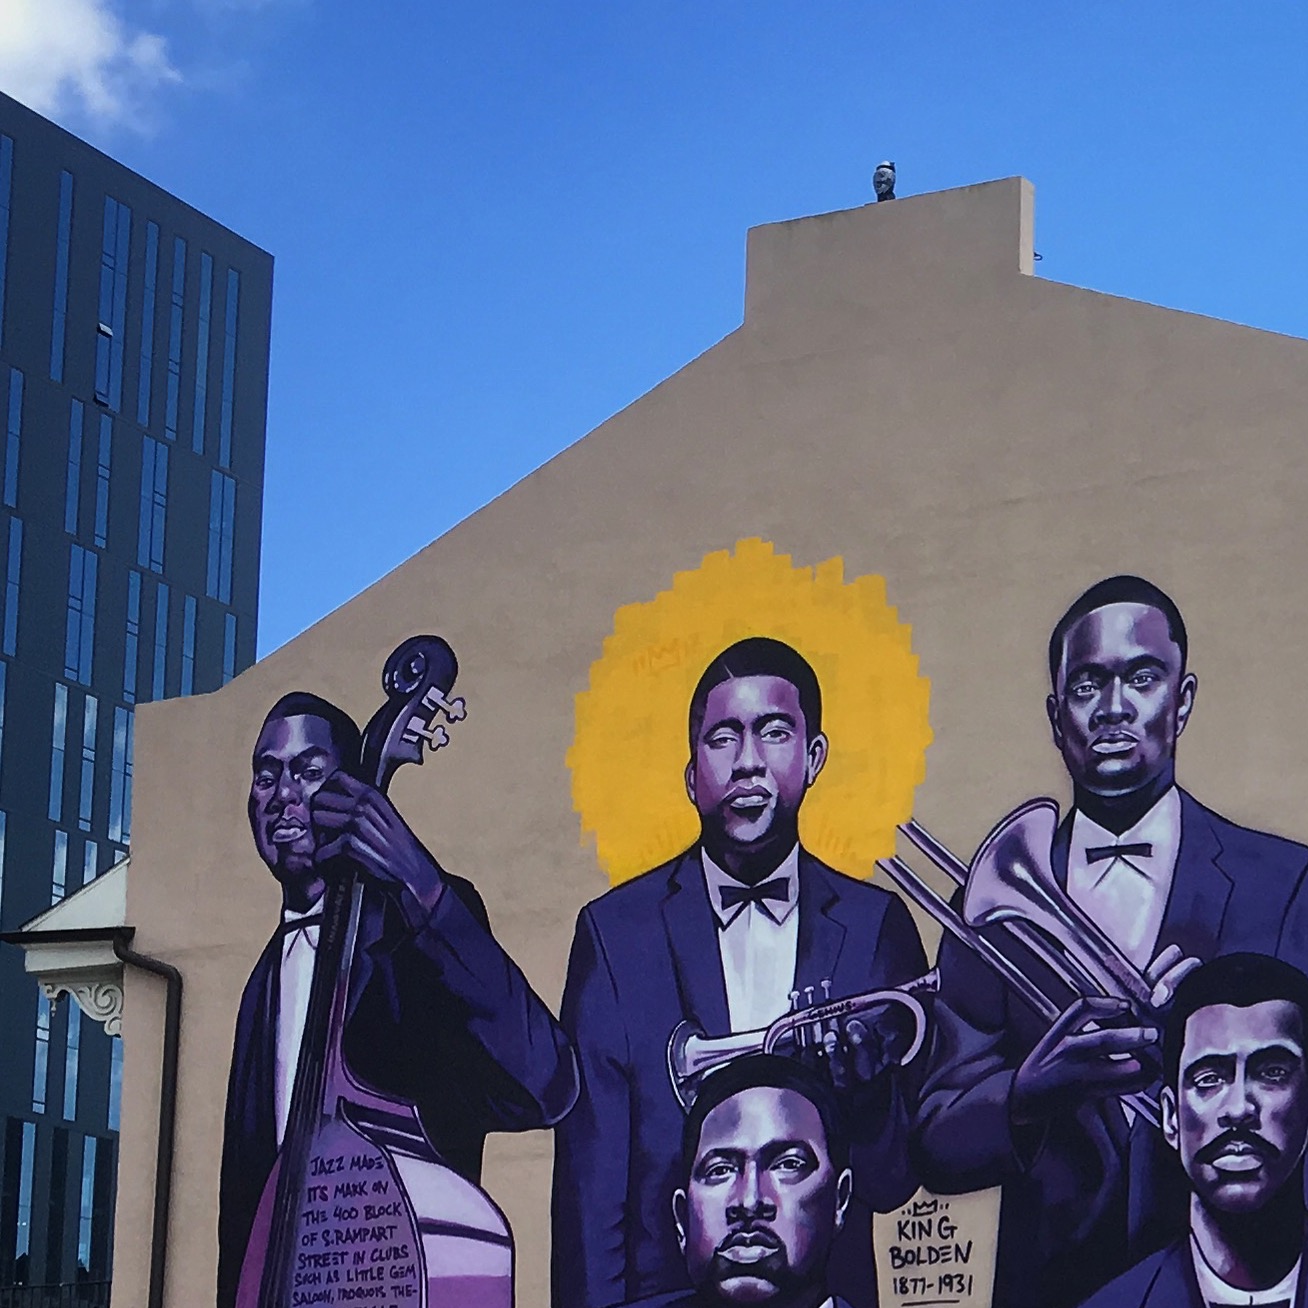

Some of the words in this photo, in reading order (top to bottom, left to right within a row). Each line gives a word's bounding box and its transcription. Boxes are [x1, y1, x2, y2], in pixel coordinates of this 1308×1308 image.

[310, 1156, 345, 1176] JAZZ
[350, 1155, 385, 1170] MADE
[307, 1184, 328, 1205] ITS
[333, 1182, 368, 1200] MARK
[372, 1180, 388, 1195] ON
[302, 1210, 328, 1226] THE
[333, 1206, 359, 1222] 400
[364, 1202, 402, 1218] BLOCK
[301, 1231, 318, 1247] OF
[897, 1216, 958, 1241] KING
[298, 1250, 349, 1271] STREET
[353, 1250, 366, 1265] IN
[370, 1245, 409, 1261] CLUBS
[888, 1240, 973, 1269] BOLDEN
[325, 1271, 340, 1285] AS
[346, 1267, 385, 1282] LITTLE
[389, 1264, 417, 1280] GEM
[893, 1274, 973, 1296] 1877-1931
[292, 1289, 335, 1307] SALOON,
